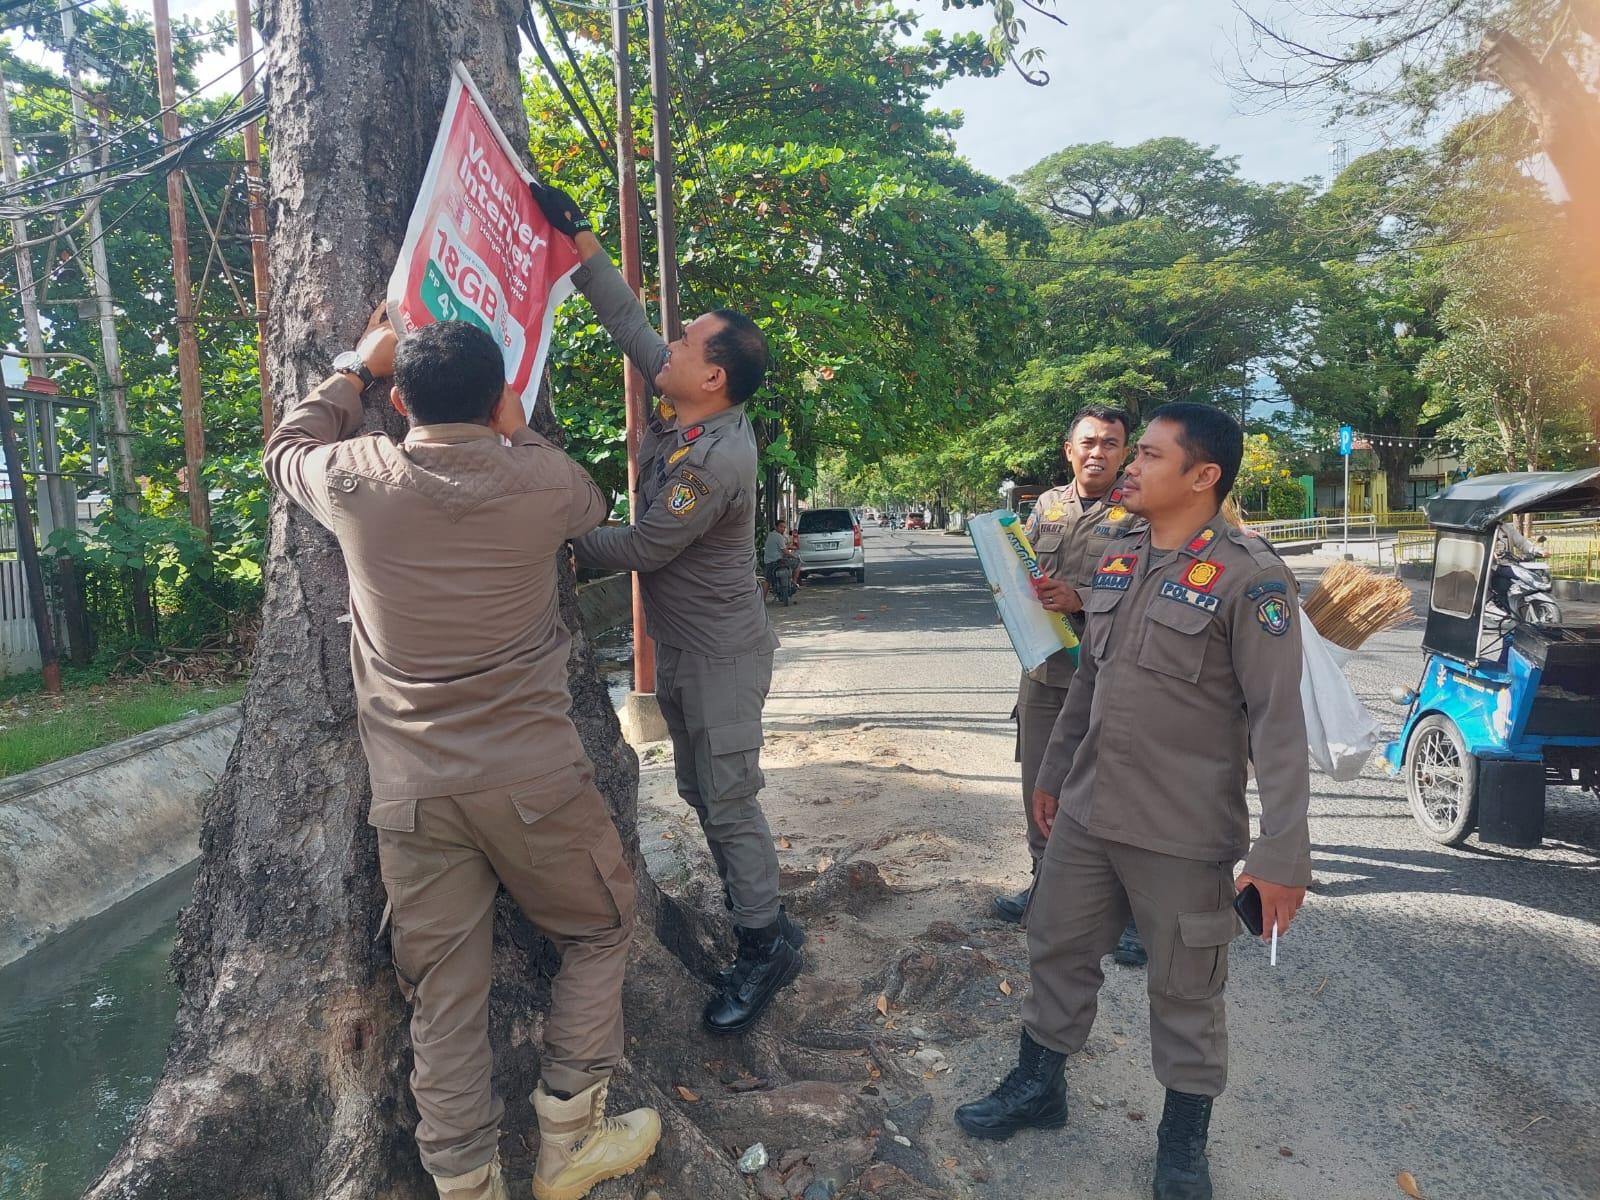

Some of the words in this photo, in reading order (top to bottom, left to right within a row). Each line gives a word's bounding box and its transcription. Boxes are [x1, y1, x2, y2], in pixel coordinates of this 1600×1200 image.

[459, 155, 533, 277] Internet
[469, 131, 546, 253] Voucher
[435, 228, 498, 322] 18GB
[1342, 430, 1349, 452] P
[1006, 533, 1044, 579] RIBUAN
[1163, 583, 1189, 603] POL
[1195, 593, 1216, 609] PP
